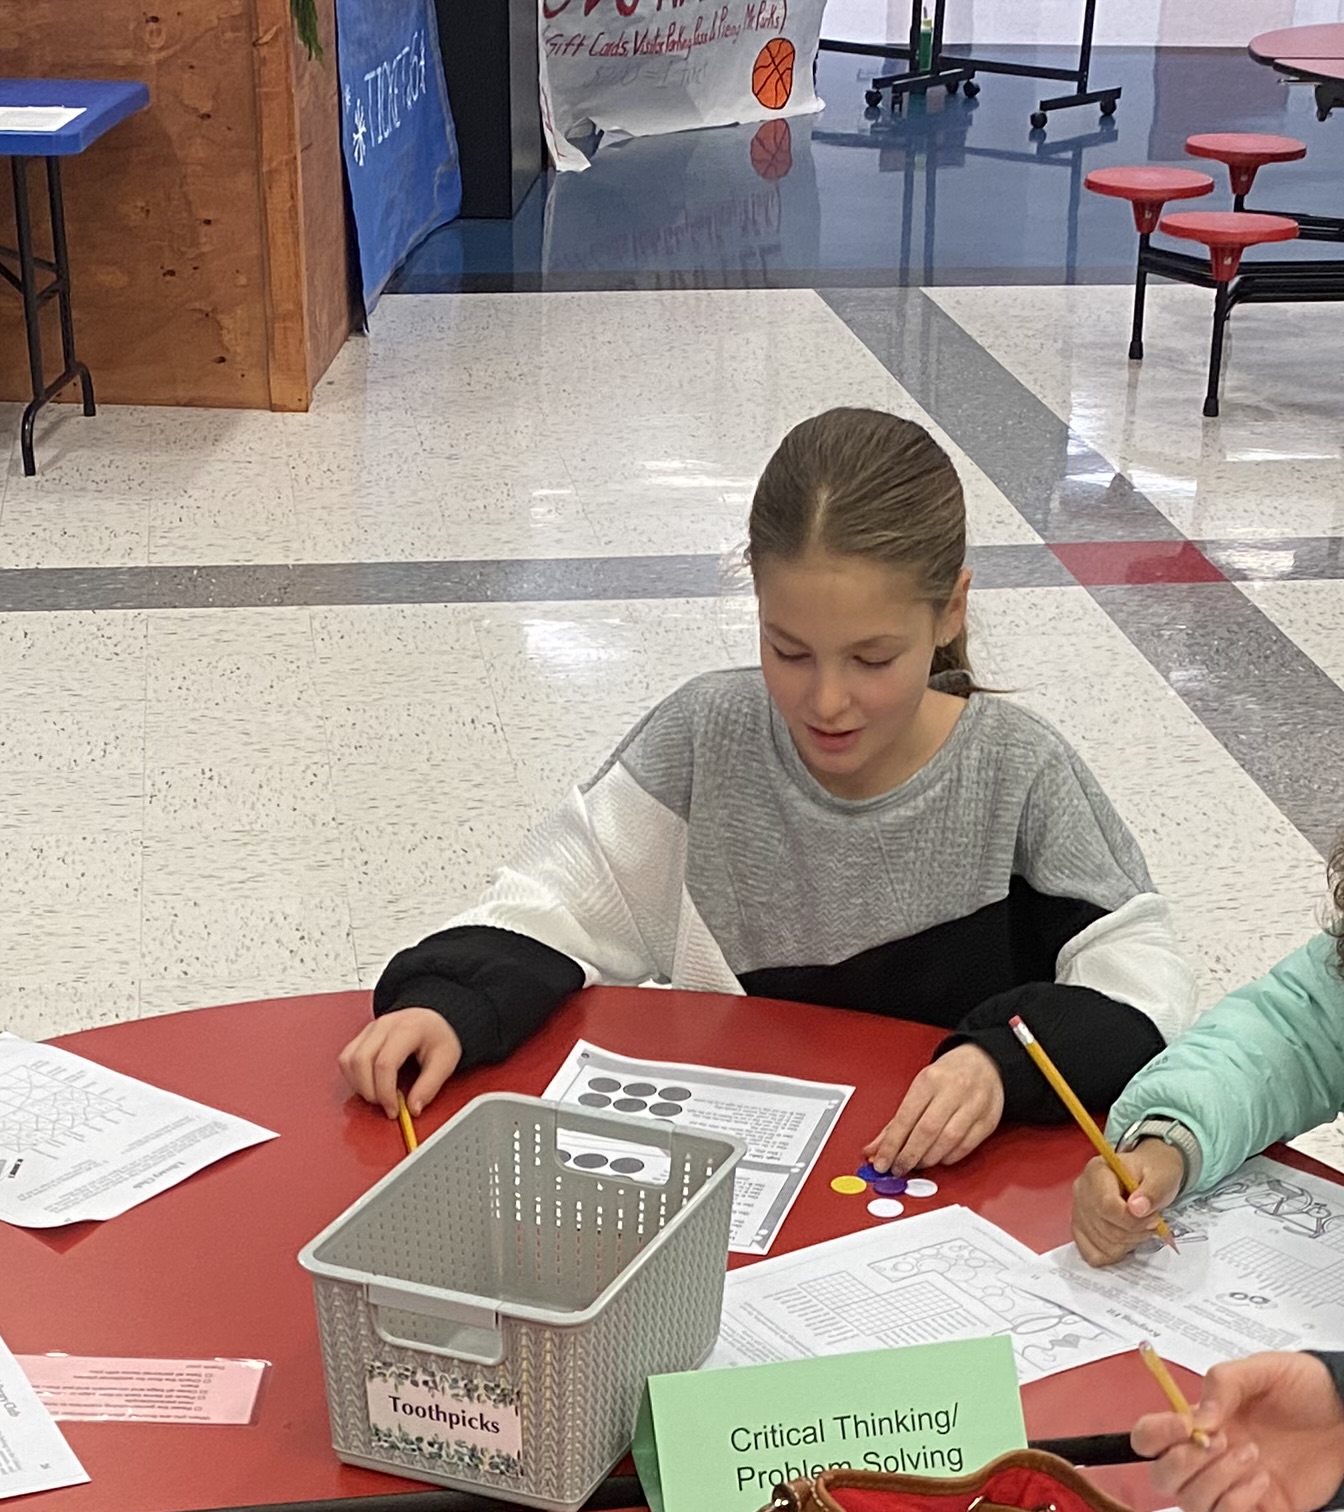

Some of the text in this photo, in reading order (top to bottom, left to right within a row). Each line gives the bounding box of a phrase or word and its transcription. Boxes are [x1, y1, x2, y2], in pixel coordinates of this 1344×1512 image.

[3, 1401, 21, 1418] Club
[388, 1395, 501, 1434] Toothpicks
[730, 1402, 959, 1452] Critical Thinking/
[862, 1445, 964, 1474] Solving
